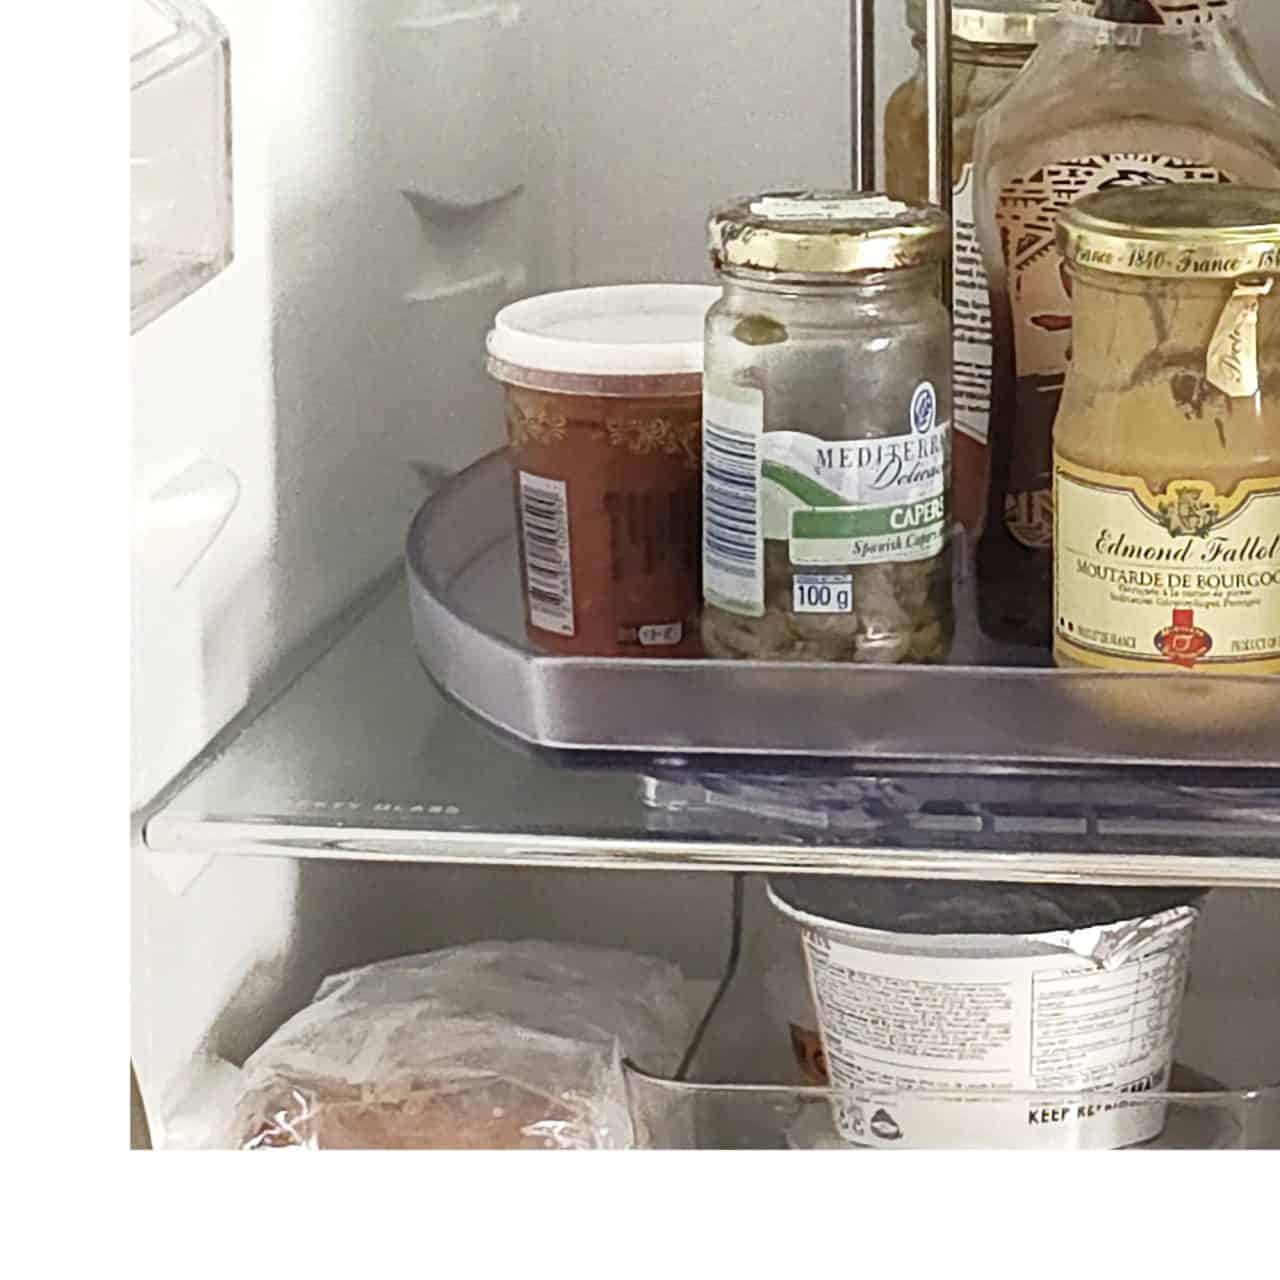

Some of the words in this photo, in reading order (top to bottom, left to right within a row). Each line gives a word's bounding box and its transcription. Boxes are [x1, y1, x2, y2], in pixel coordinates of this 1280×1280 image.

[1176, 249, 1240, 273] France
[1095, 528, 1193, 562] Edmond
[1201, 534, 1280, 563] Fallot
[1076, 558, 1165, 587] MOUTARDE
[1168, 574, 1192, 588] DE
[797, 585, 831, 606] 100
[837, 589, 849, 609] g
